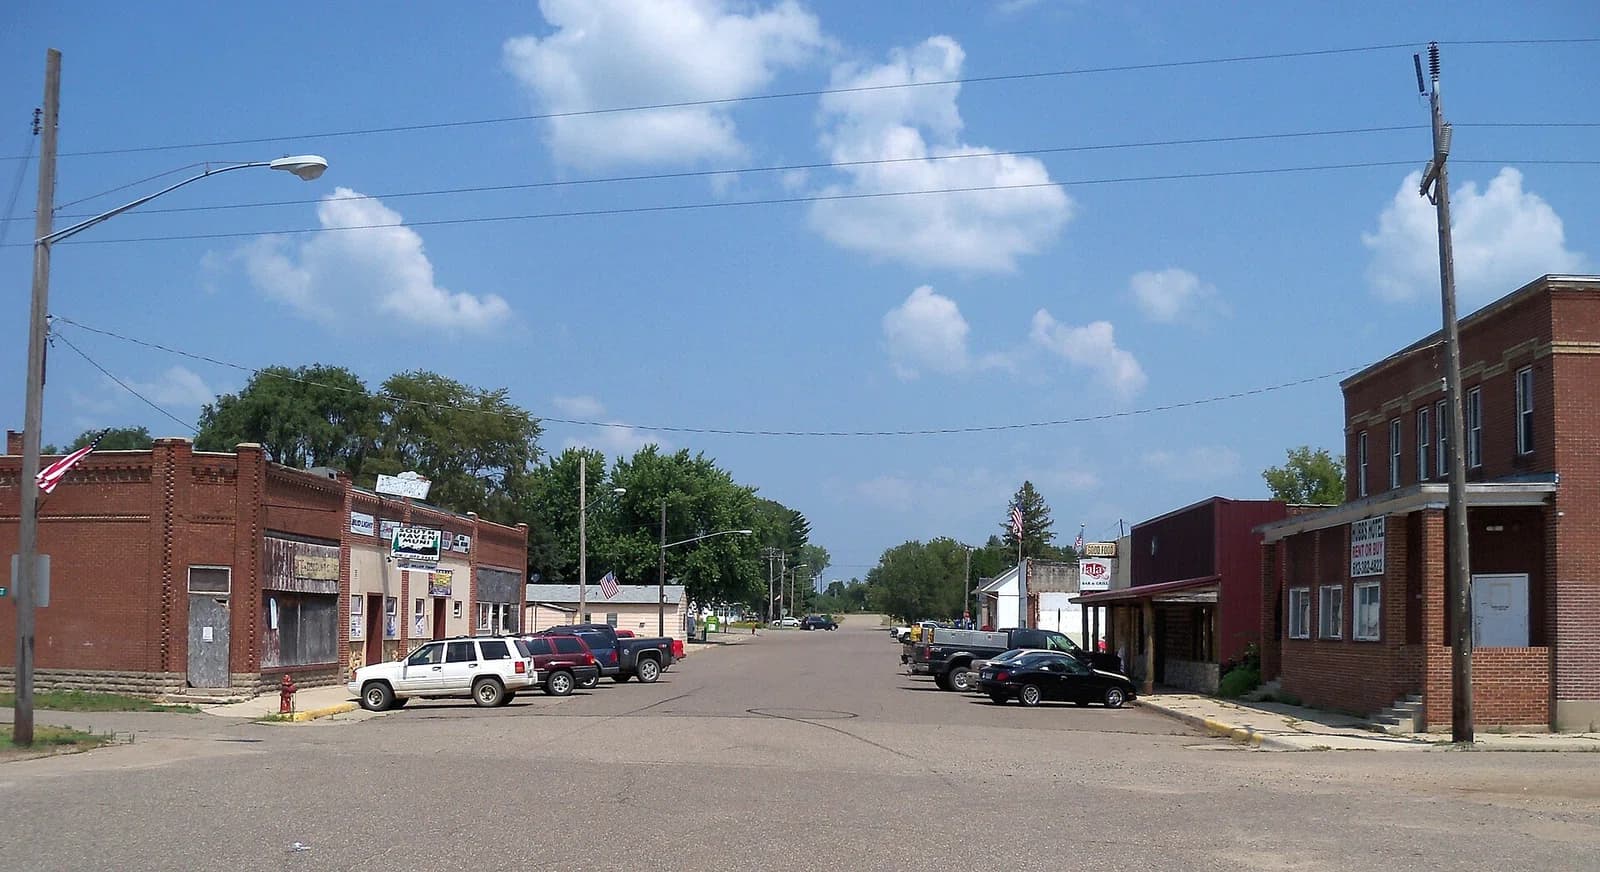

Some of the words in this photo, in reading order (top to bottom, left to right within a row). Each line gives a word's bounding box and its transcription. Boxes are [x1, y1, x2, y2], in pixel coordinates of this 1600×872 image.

[399, 528, 435, 536] SOUTH
[1088, 544, 1101, 555] GOOD
[1101, 544, 1114, 555] FOOD
[1353, 543, 1365, 558] RENT
[1373, 541, 1384, 556] BUY
